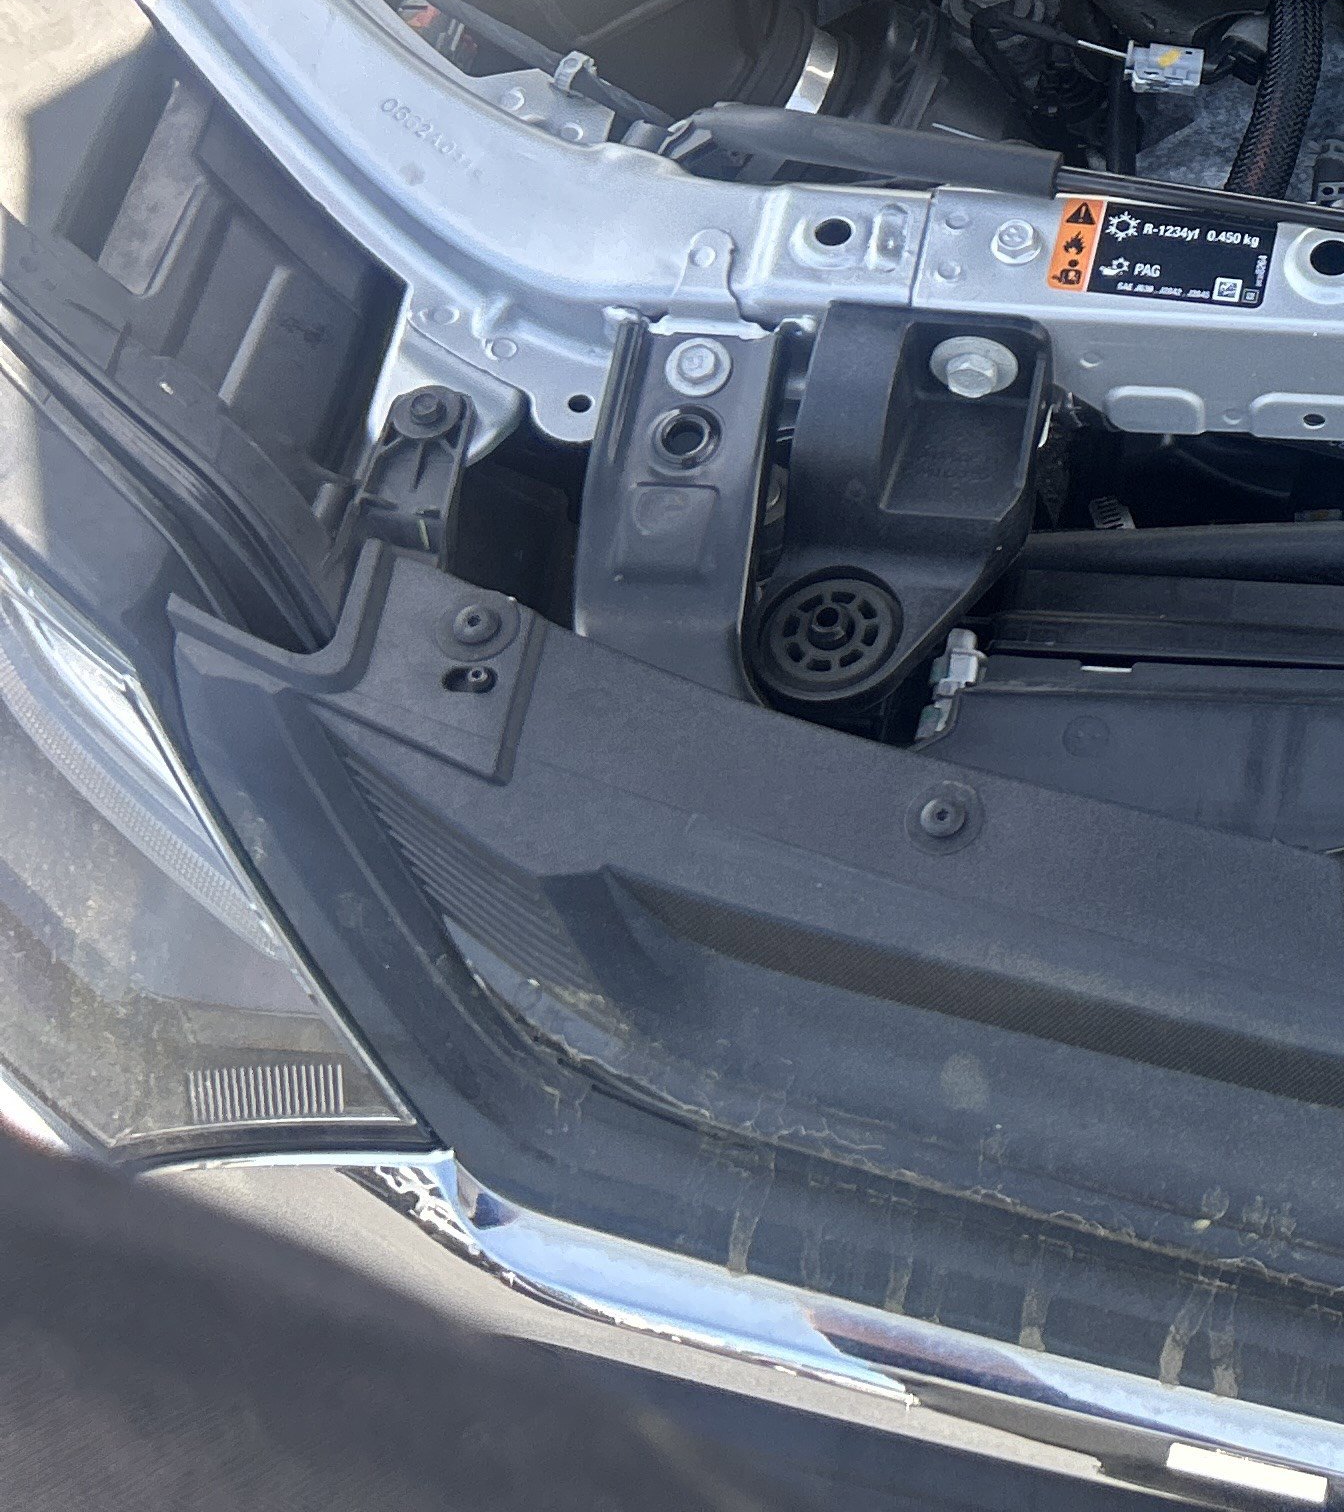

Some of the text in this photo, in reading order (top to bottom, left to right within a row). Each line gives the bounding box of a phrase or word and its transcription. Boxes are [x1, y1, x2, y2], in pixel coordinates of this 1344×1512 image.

[1142, 222, 1260, 248] R-1234yf 0.450 kg
[1133, 262, 1161, 278] PAG
